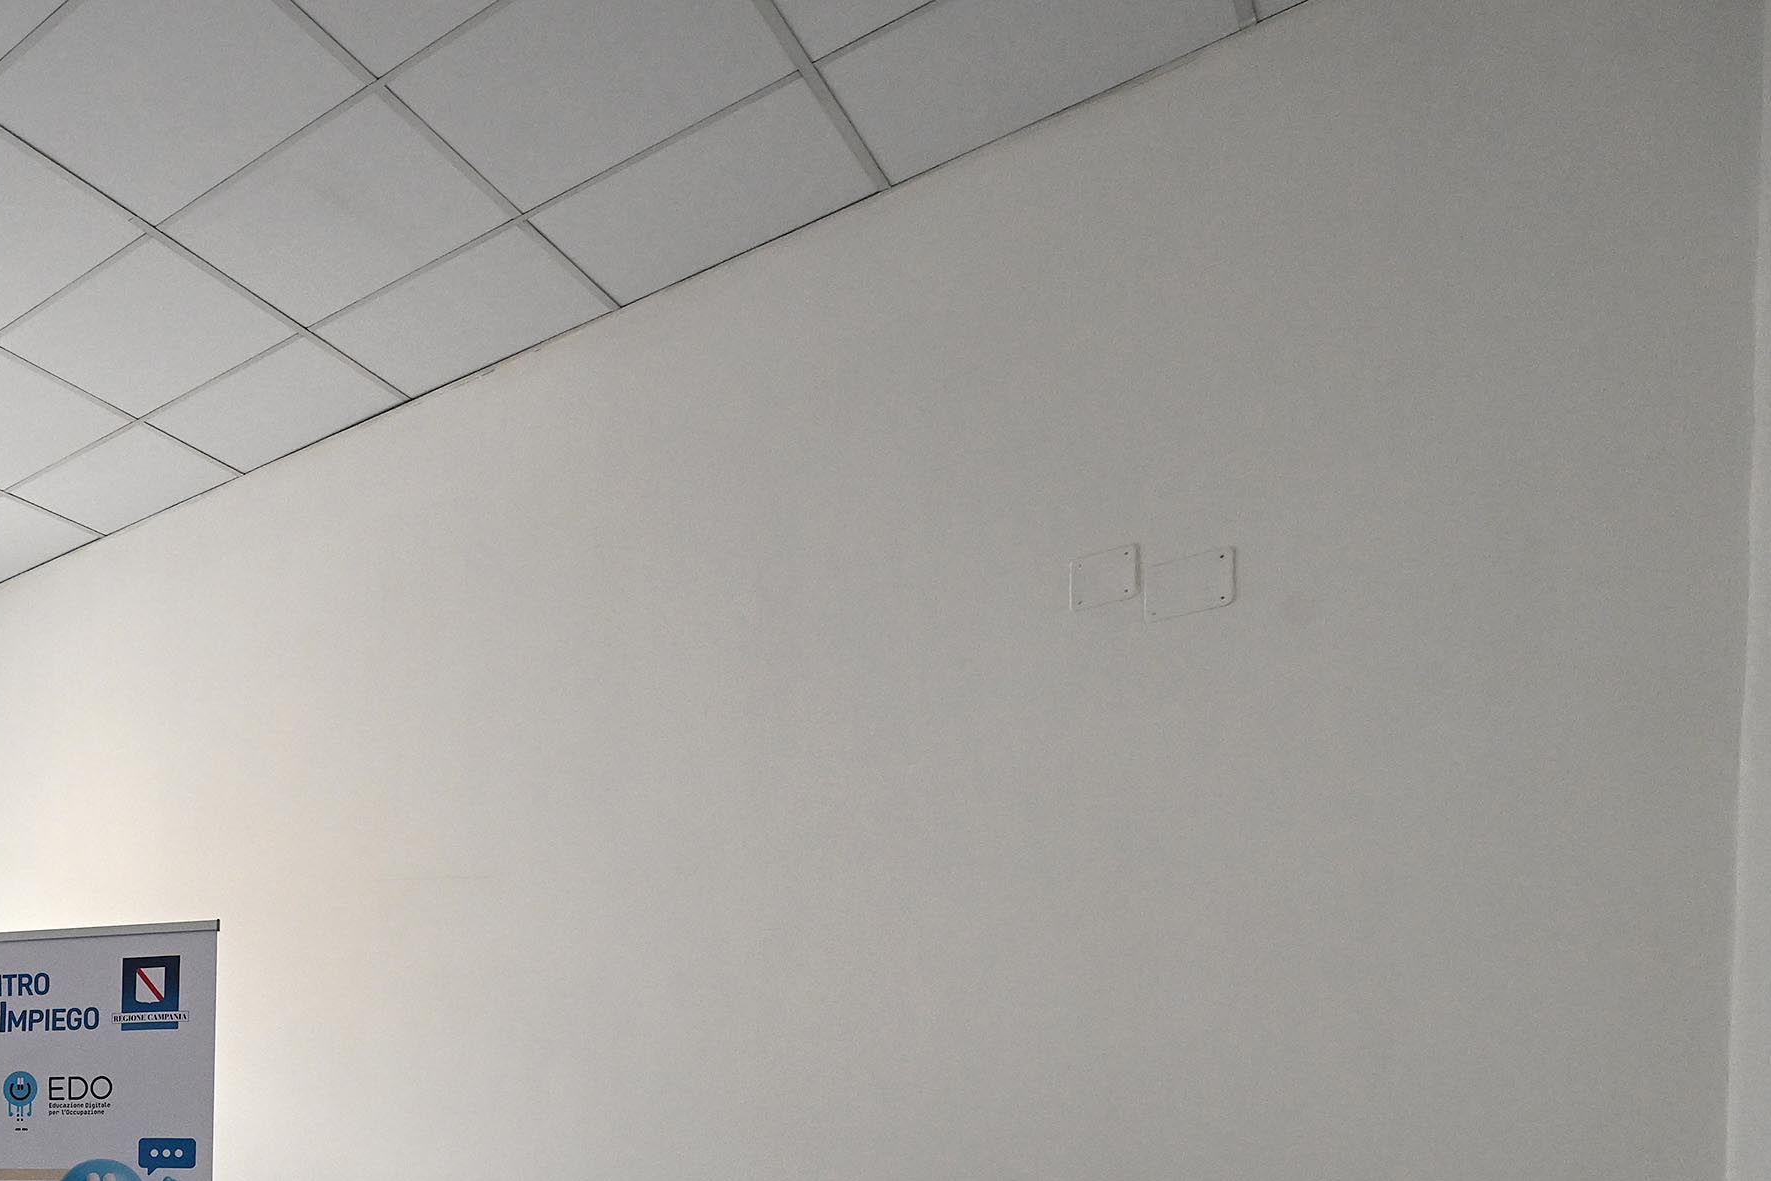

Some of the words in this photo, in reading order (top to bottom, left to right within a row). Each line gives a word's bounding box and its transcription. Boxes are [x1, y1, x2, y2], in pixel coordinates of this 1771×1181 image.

[113, 1013, 146, 1023] REGIONE
[147, 1012, 188, 1022] CAMPANIA
[48, 1075, 113, 1100] EDO
